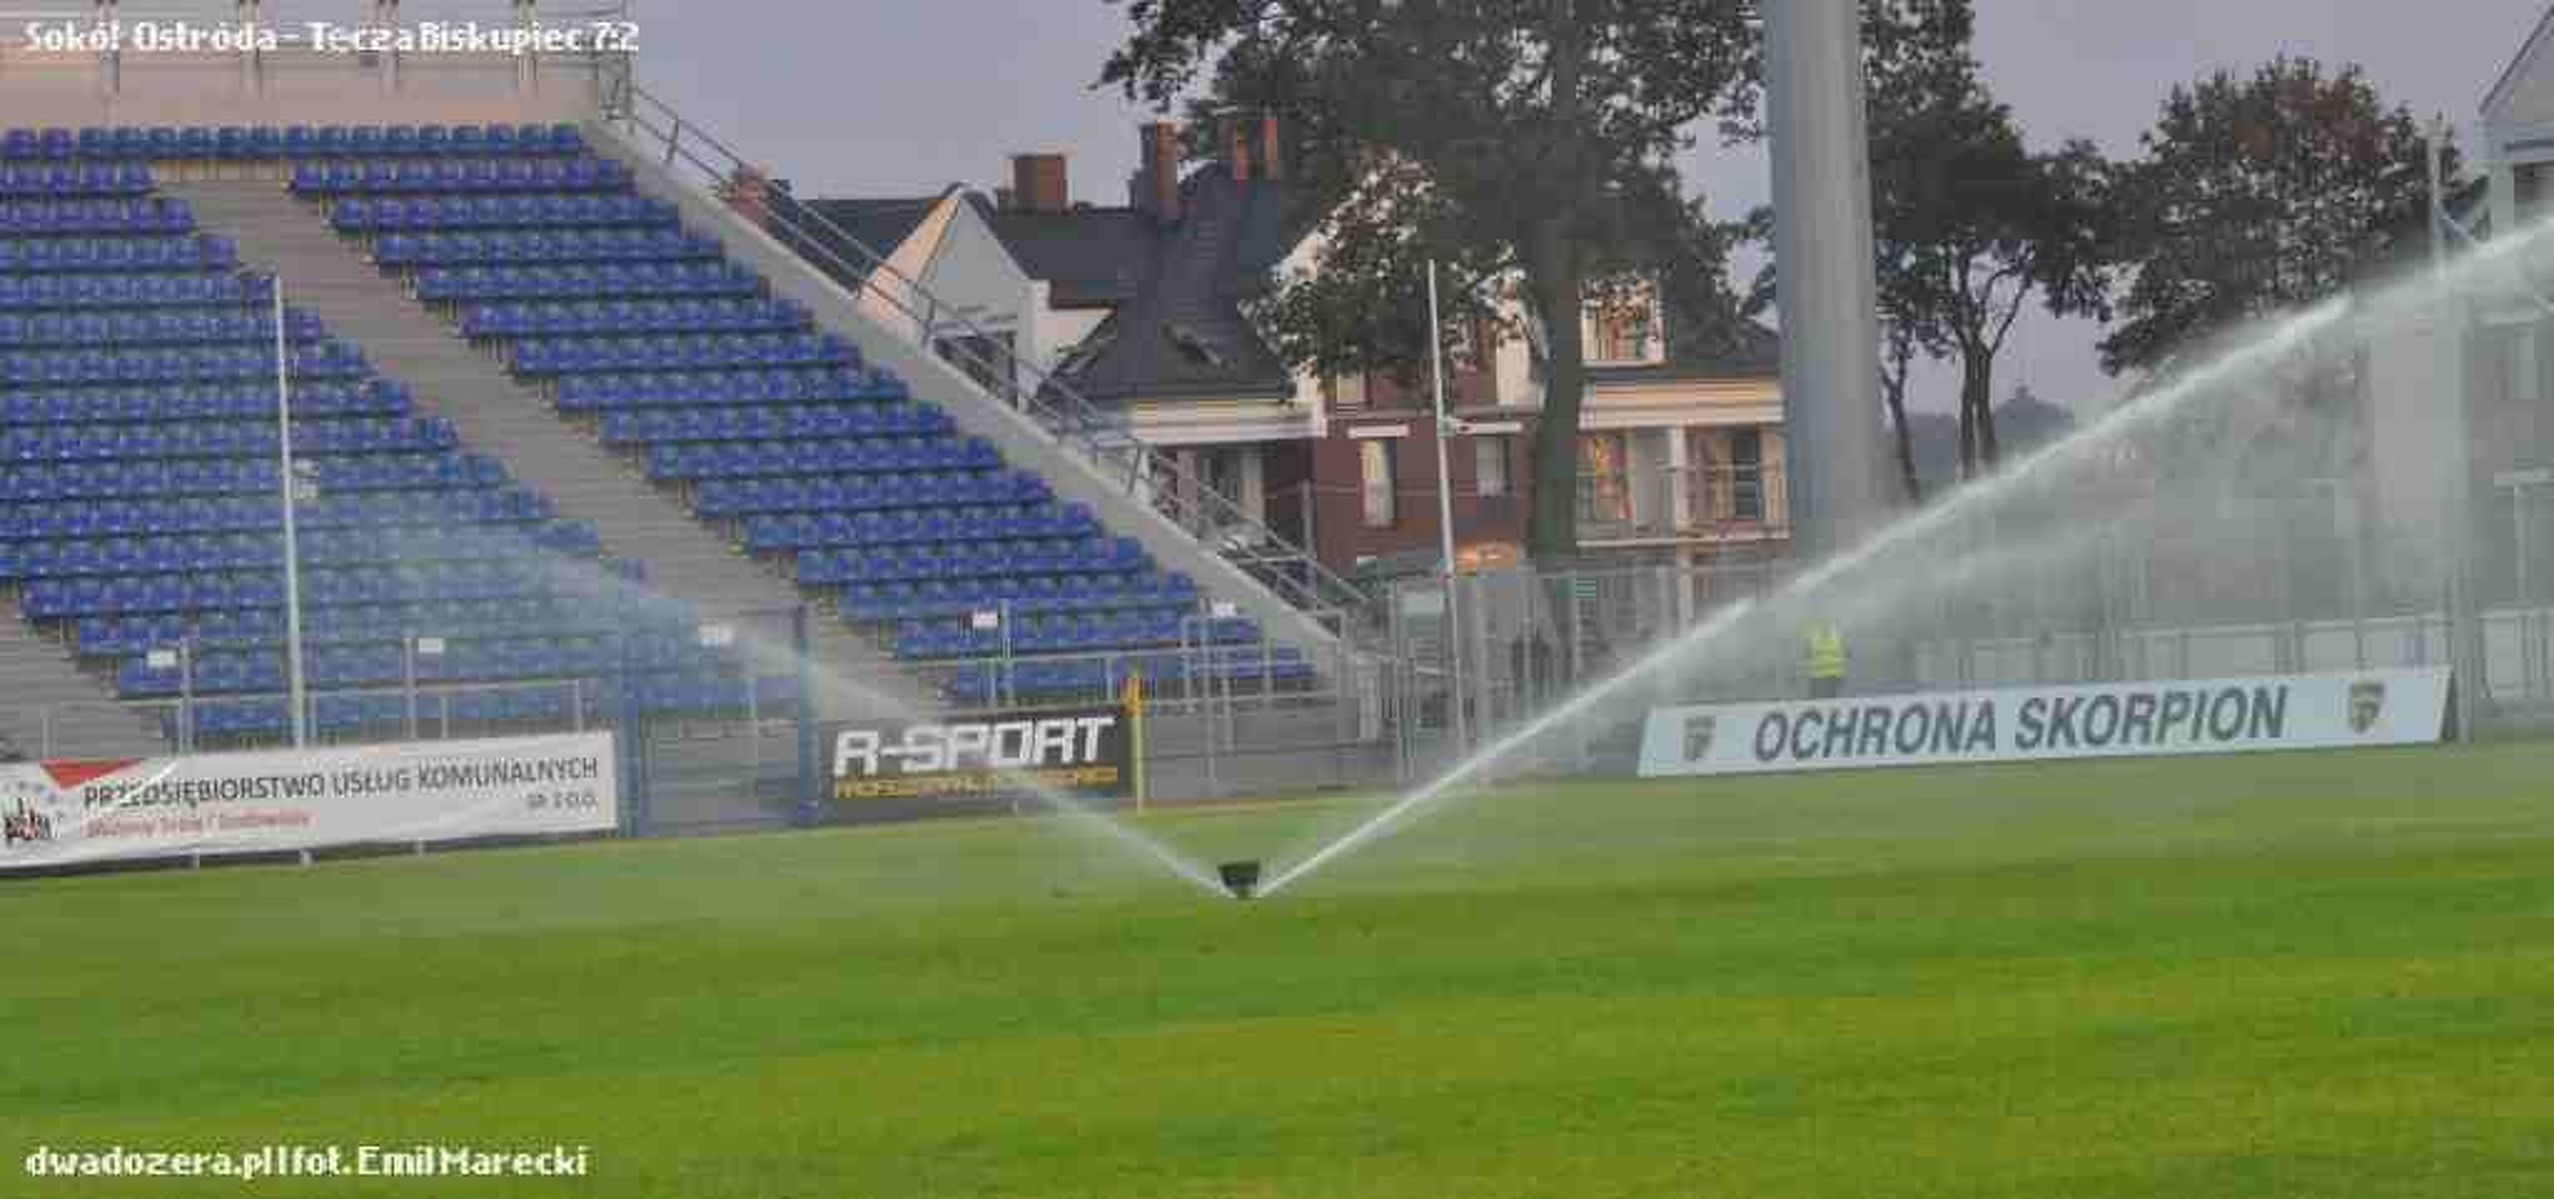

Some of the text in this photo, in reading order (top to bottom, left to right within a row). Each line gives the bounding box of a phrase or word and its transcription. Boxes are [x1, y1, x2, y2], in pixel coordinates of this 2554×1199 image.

[833, 715, 1116, 777] R-SPORT
[1754, 684, 2289, 762] OCHRONA SKORPION
[417, 756, 598, 790] KOMUNALNYCH
